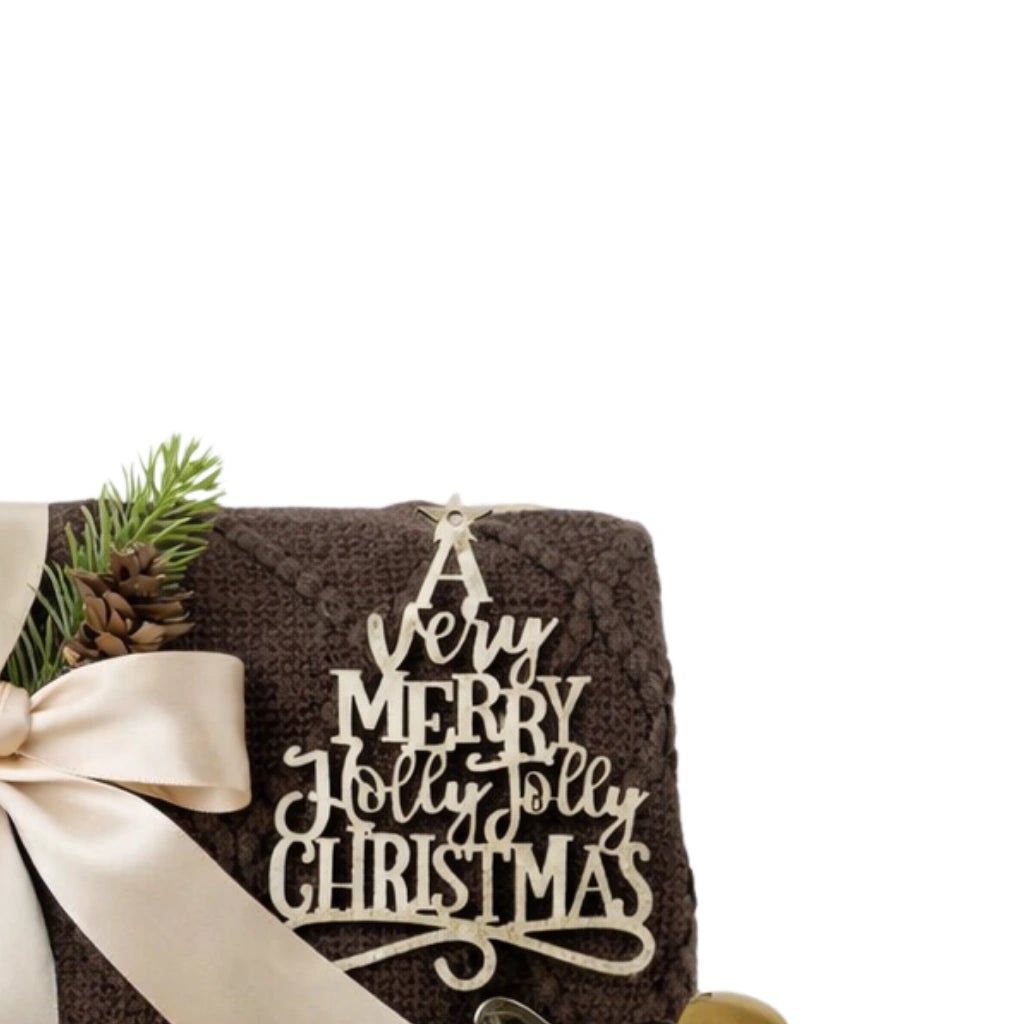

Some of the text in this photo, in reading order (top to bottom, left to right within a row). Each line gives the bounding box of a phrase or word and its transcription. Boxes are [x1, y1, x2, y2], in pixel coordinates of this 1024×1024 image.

[416, 533, 493, 608] A
[367, 602, 559, 688] Very
[330, 669, 592, 766] MERRY
[275, 744, 649, 852] Holly Jolly
[269, 831, 654, 925] CHRISTMAS
